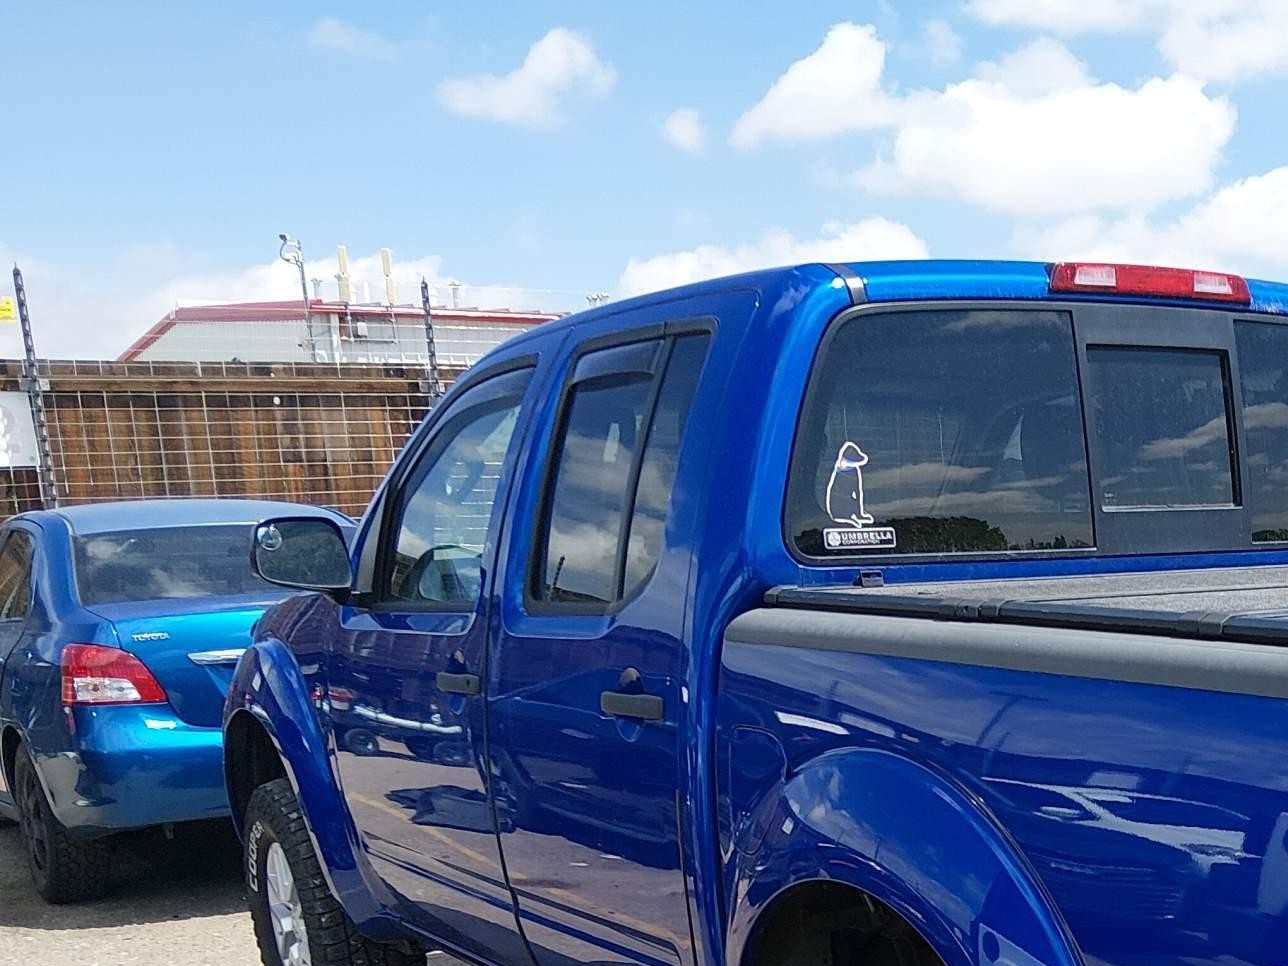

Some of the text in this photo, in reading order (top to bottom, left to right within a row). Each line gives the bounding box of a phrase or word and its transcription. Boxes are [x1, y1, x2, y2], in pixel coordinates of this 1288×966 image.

[841, 531, 893, 541] UMBRELLA
[131, 632, 170, 642] TOYOTA
[248, 821, 265, 892] COOPER
